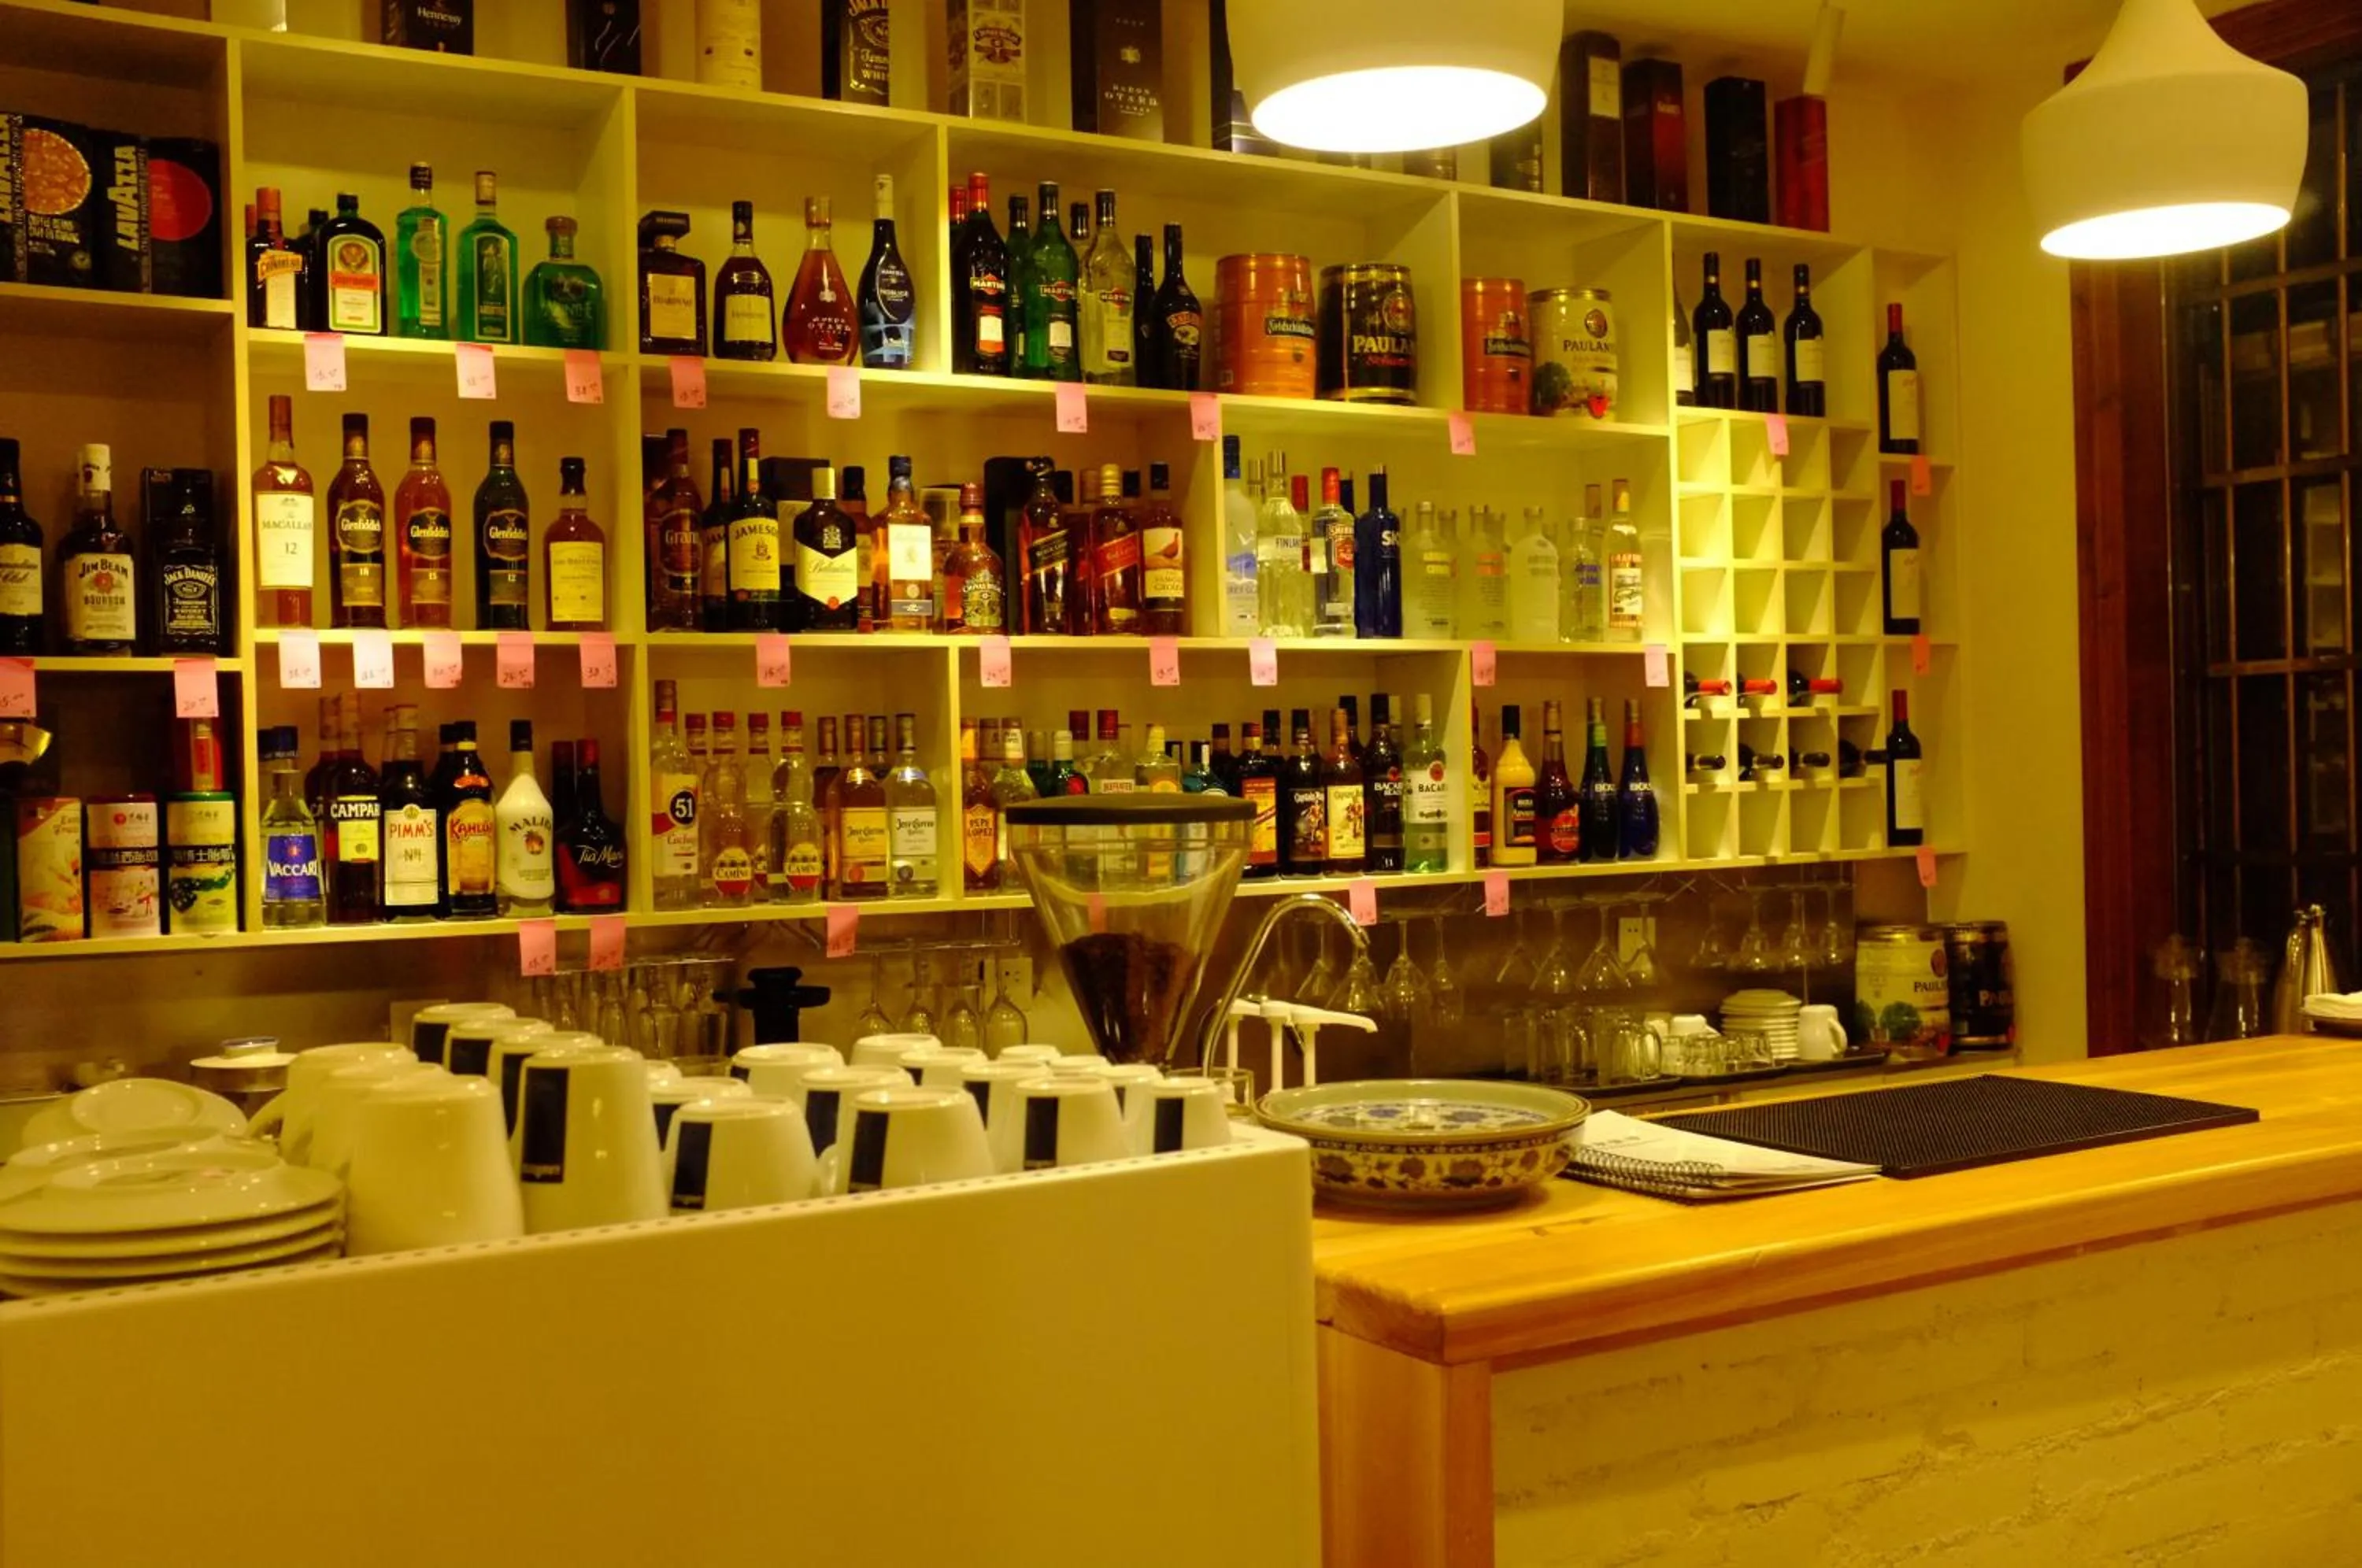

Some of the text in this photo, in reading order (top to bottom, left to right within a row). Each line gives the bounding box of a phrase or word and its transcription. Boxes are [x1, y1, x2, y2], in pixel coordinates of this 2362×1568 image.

[417, 6, 462, 25] Hennessy
[1104, 91, 1158, 106] OTARD
[107, 146, 140, 251] LAVAZZA
[284, 542, 298, 555] 12
[79, 558, 128, 579] JIM BEAM
[164, 570, 185, 586] JACK
[675, 797, 694, 818] 51
[390, 819, 434, 838] PIMM'S
[268, 860, 318, 877] VACCARI
